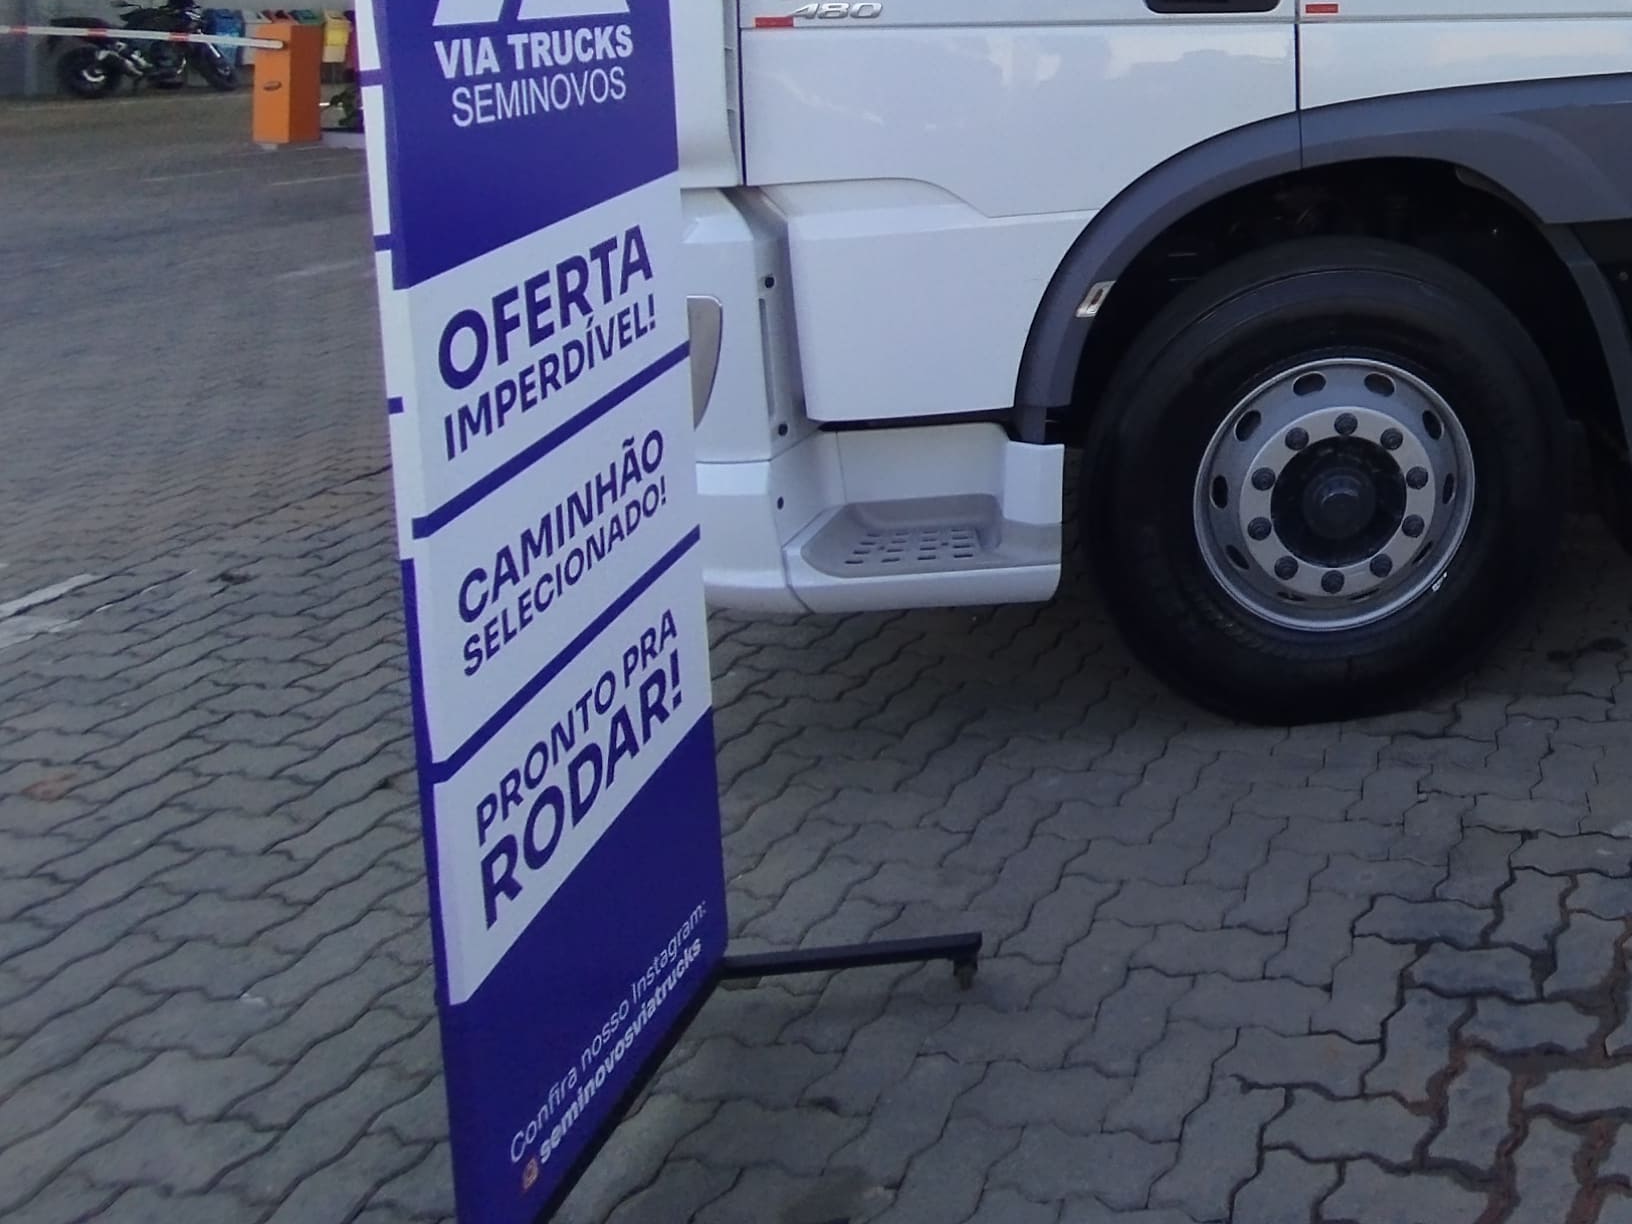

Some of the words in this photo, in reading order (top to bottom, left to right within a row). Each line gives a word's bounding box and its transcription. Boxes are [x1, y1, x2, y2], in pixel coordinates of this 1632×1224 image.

[434, 36, 500, 79] VIA
[507, 24, 634, 70] TRUCKS
[787, 2, 884, 20] 480
[452, 66, 627, 127] SEMINOVOS
[438, 224, 654, 391] OFERTA
[444, 293, 656, 462] IMPERDÍVEL!
[458, 429, 664, 623] CAMINHÃO
[463, 476, 667, 677] SELECIONADO!
[476, 670, 616, 847] PRONTO
[622, 609, 678, 689] PRA
[481, 648, 682, 930] RODAR!
[510, 1065, 578, 1163] Confira
[580, 999, 629, 1072] nosso
[540, 938, 702, 1164] seminovosviatrucks
